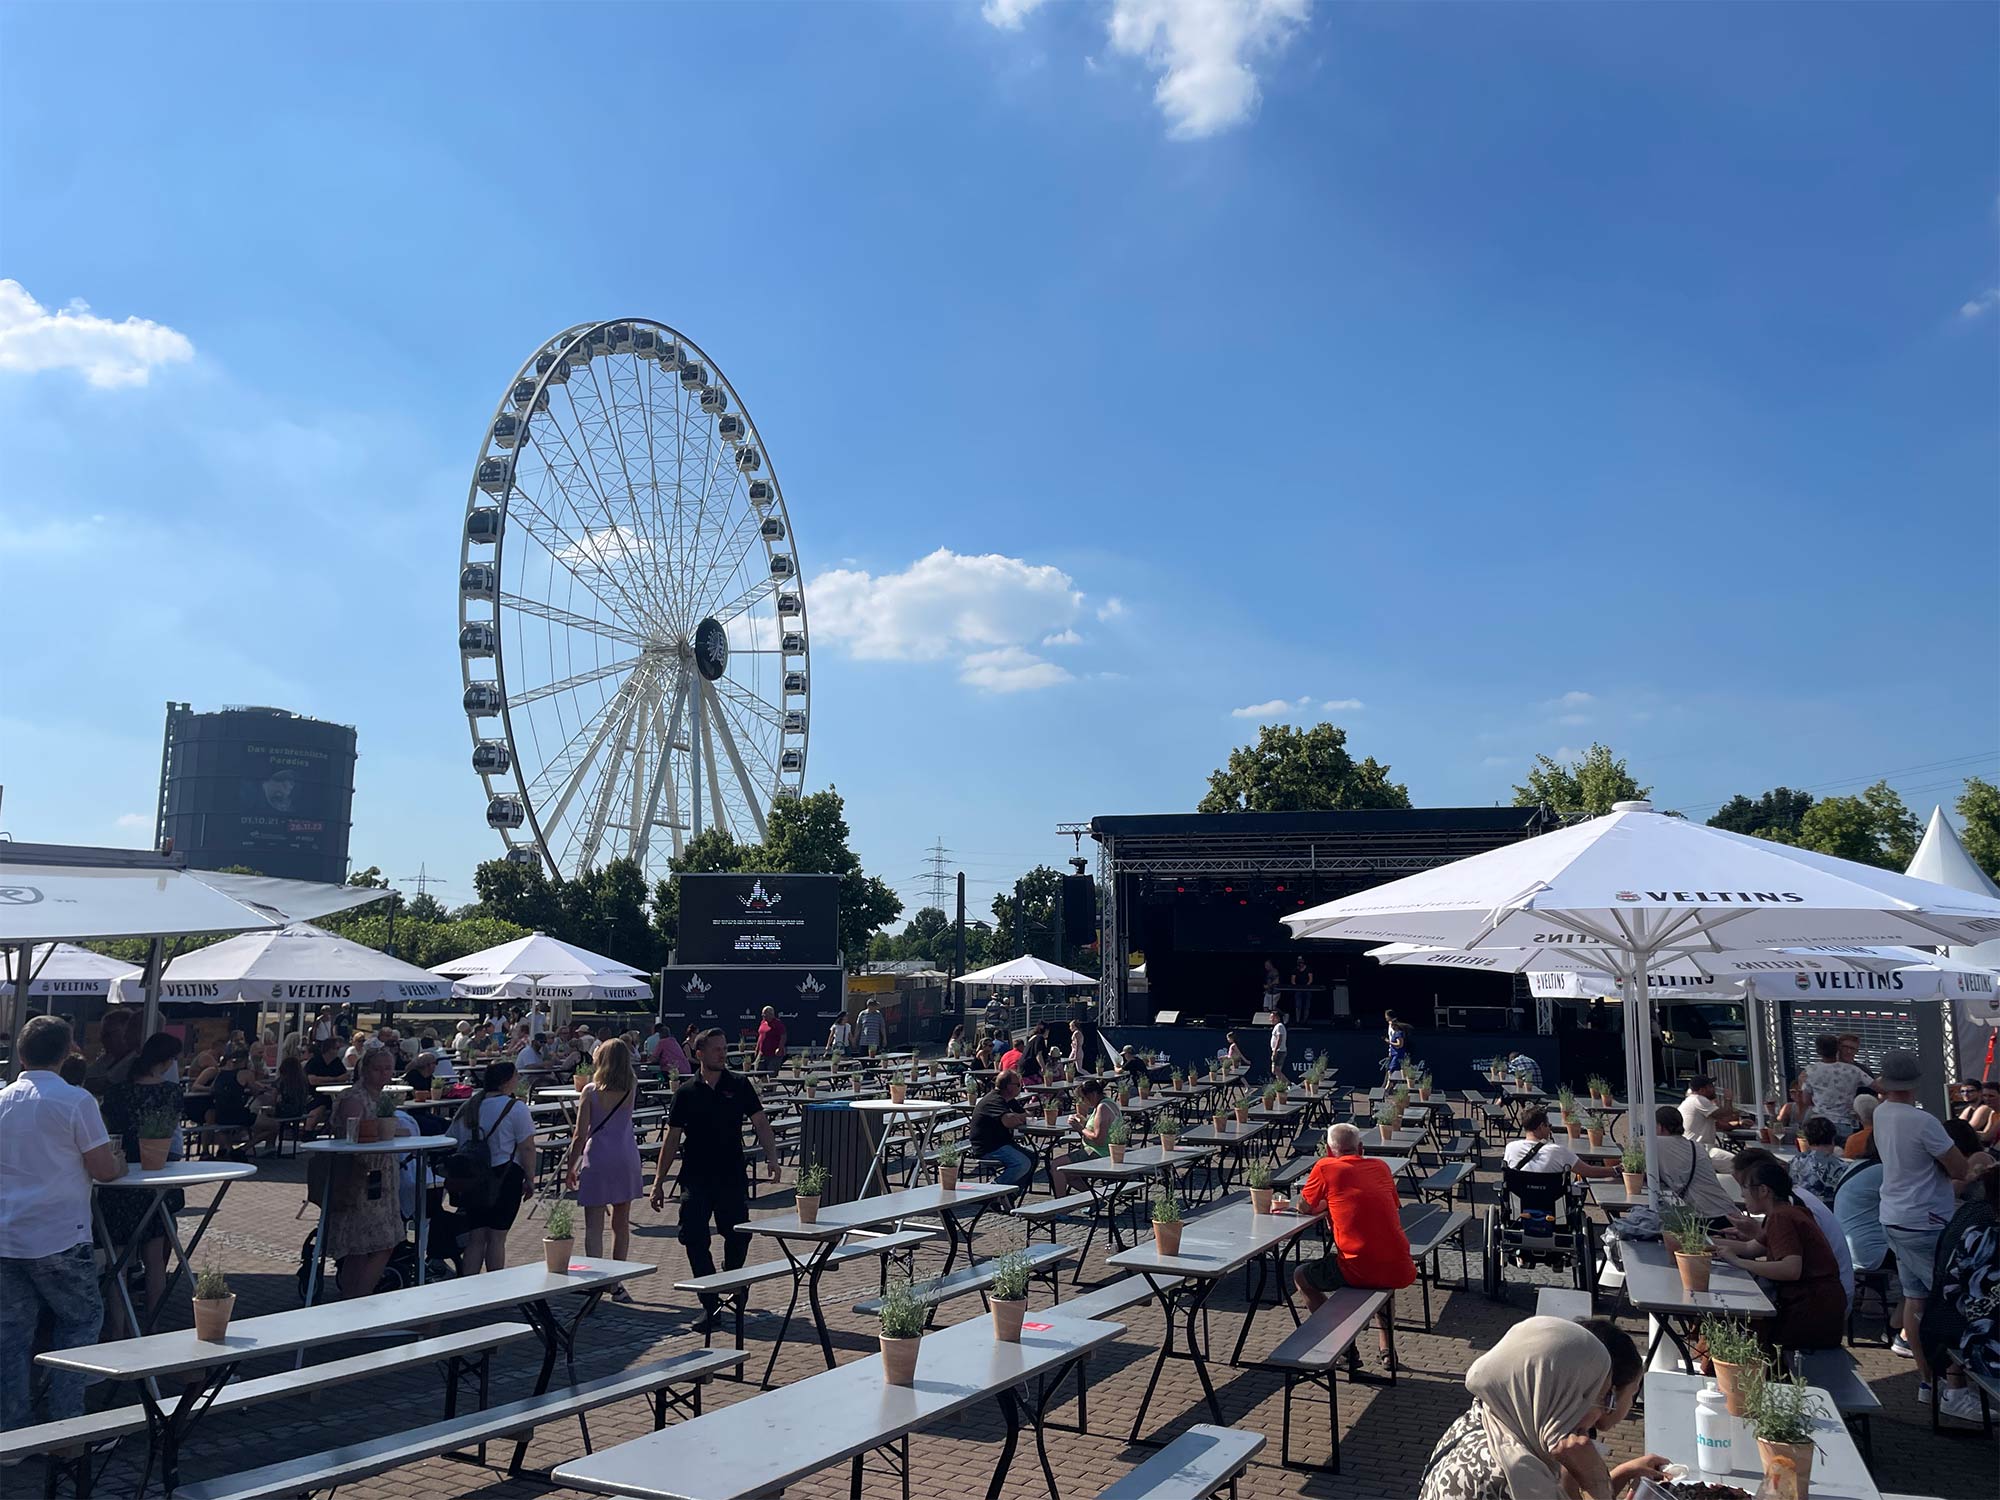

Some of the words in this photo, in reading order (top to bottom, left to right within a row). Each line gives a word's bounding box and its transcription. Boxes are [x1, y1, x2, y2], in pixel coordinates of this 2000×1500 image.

[1645, 891, 1805, 903] VELTINS
[54, 981, 99, 992] VELTINS
[1541, 973, 1565, 990] VELTINS
[1814, 971, 1904, 990] VELTINS
[1964, 973, 1992, 993] VELTINS
[167, 983, 219, 997] VELTINS
[288, 984, 350, 998] VELTINS
[535, 987, 573, 998] VELTINS
[609, 988, 638, 998] VELTINS
[1292, 1062, 1315, 1071] VELT
